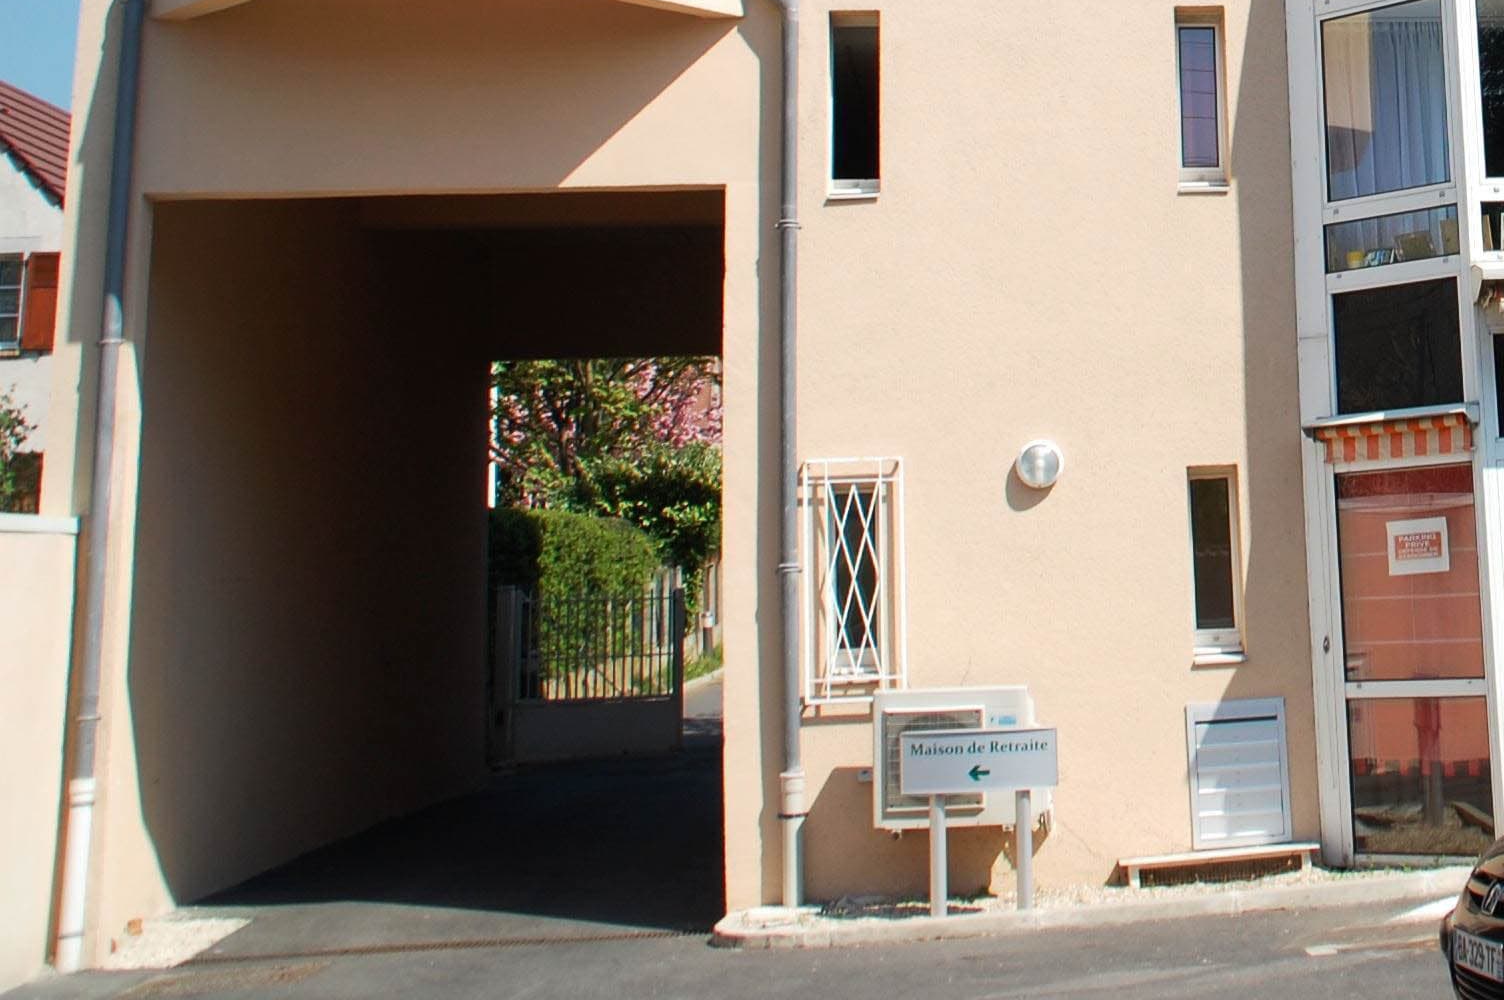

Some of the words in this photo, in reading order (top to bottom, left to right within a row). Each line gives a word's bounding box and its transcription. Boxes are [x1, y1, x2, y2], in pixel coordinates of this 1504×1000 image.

[910, 743, 963, 757] Maison
[967, 740, 986, 754] de
[990, 739, 1048, 753] Retraite
